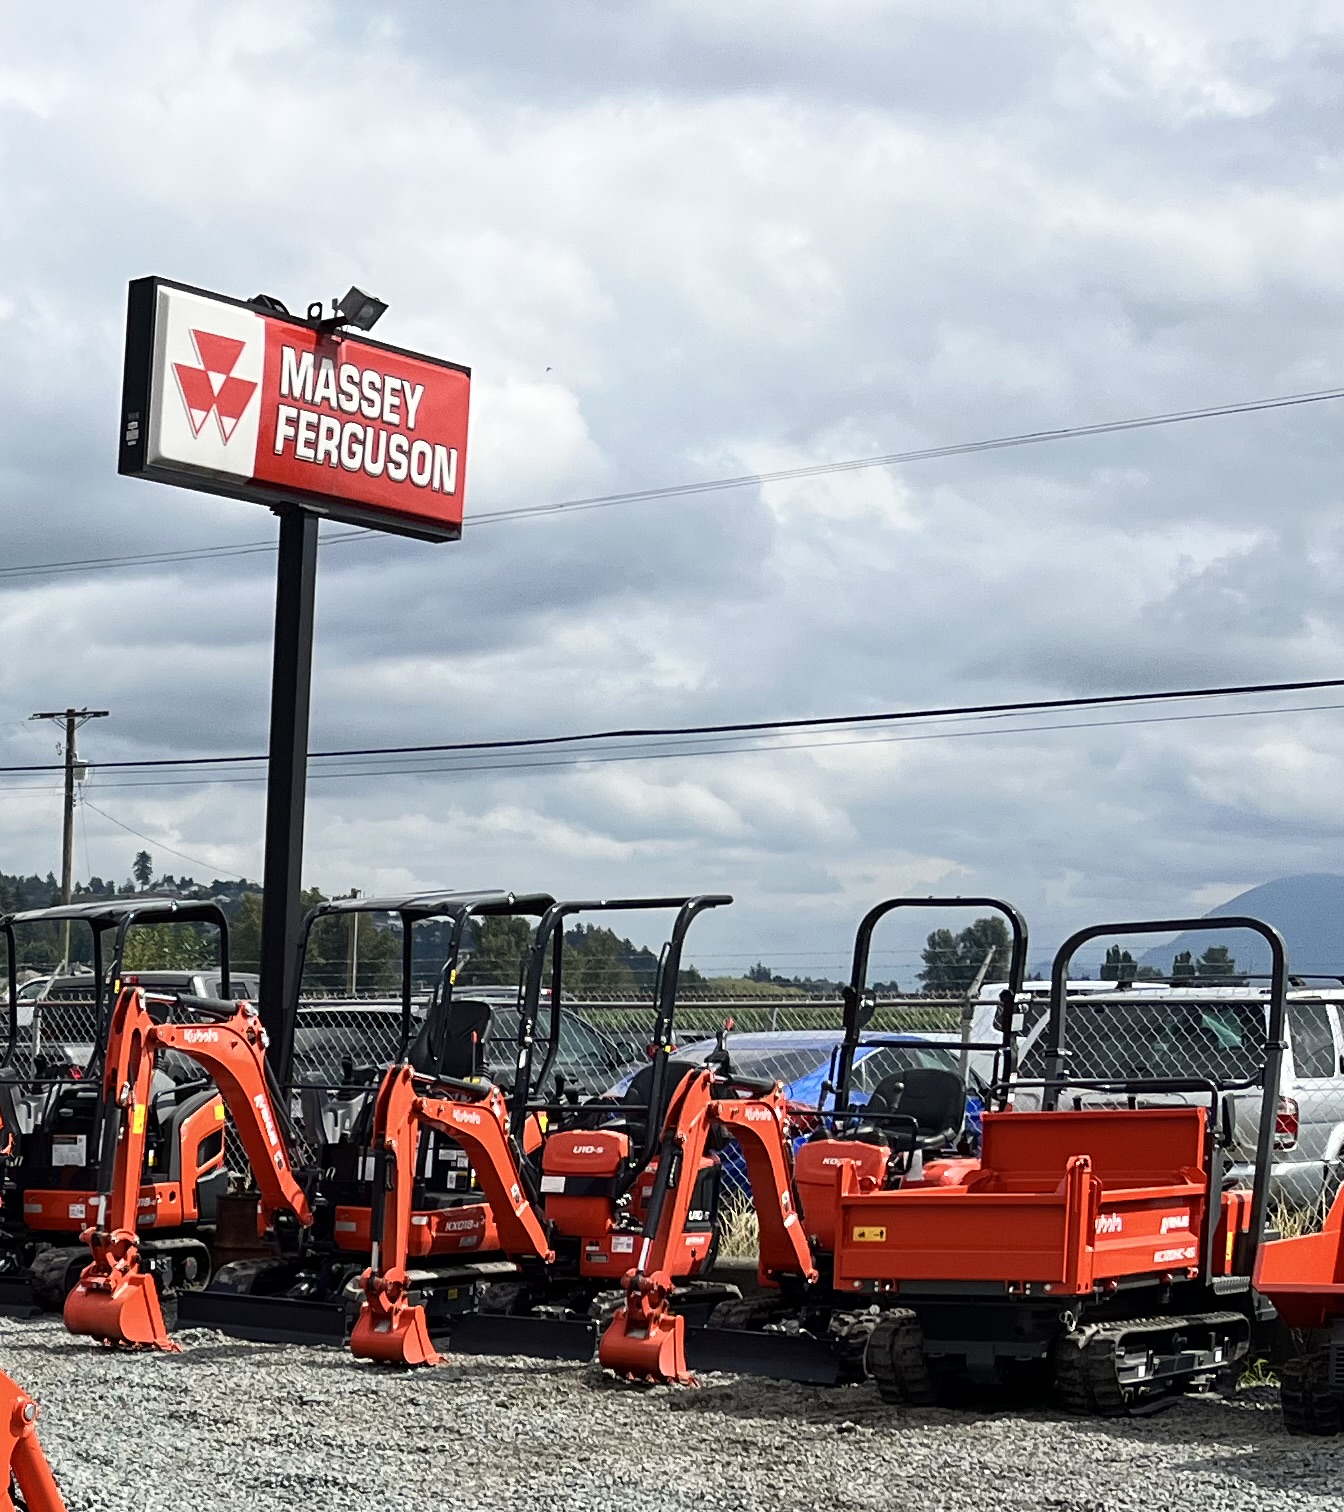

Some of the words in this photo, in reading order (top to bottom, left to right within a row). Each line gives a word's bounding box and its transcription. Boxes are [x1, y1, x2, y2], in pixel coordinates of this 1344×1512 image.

[279, 345, 424, 430] MASSEY
[273, 403, 458, 495] FERGUSON
[183, 1029, 218, 1043] Kubota
